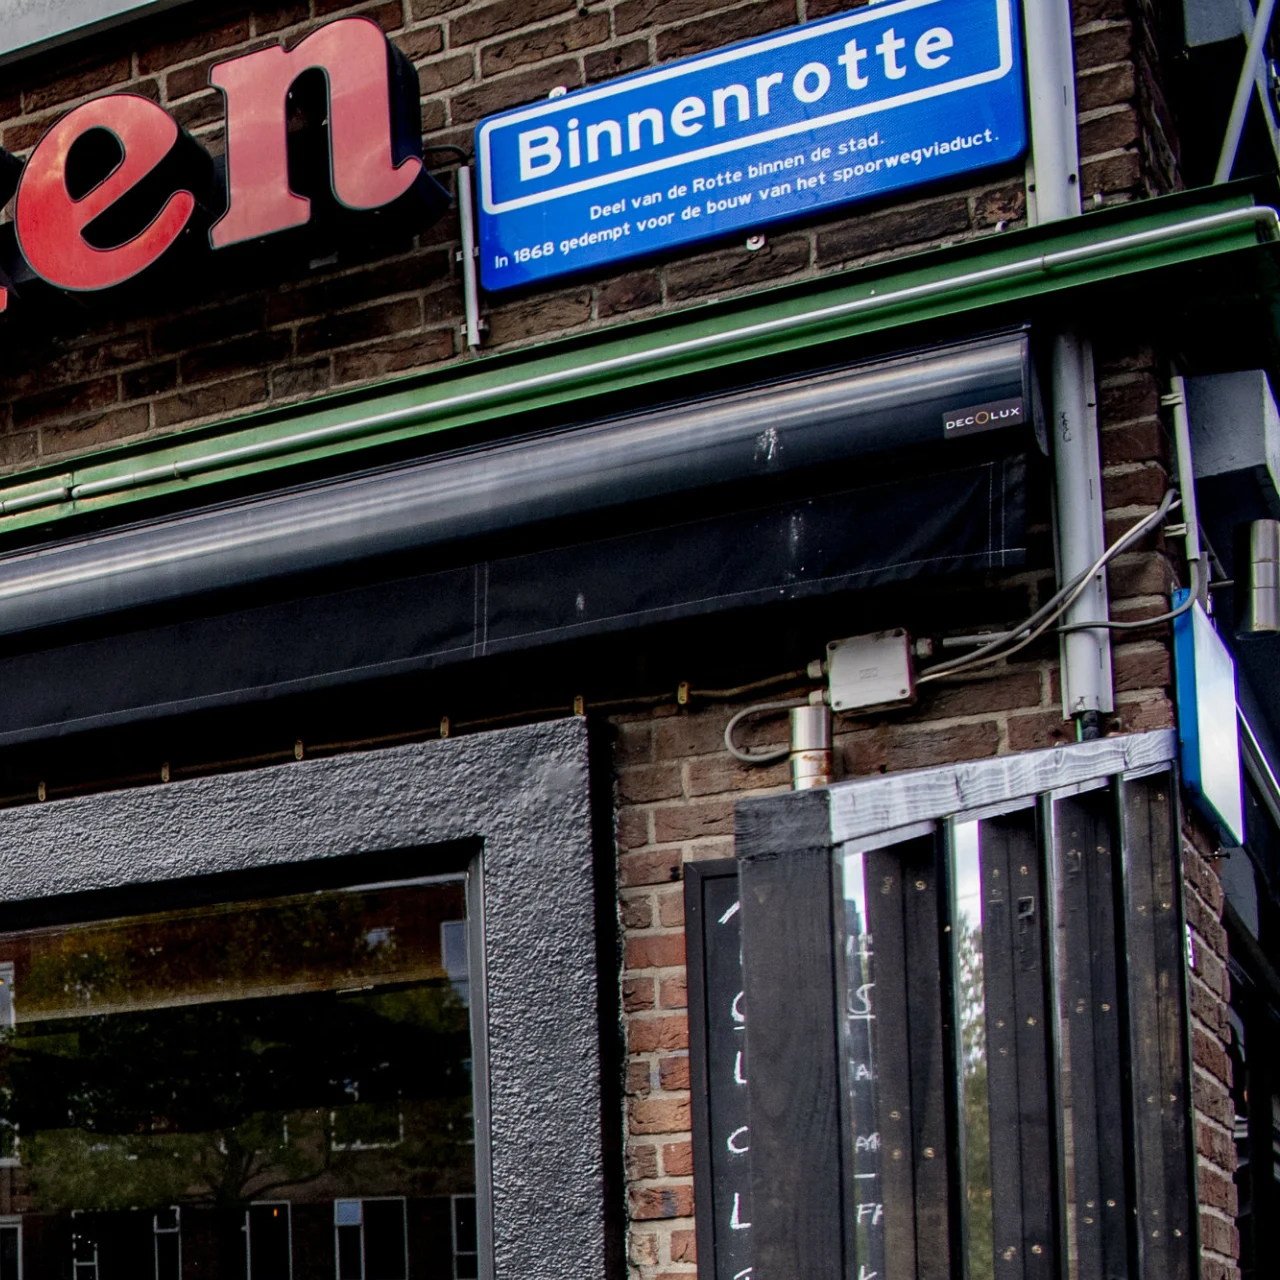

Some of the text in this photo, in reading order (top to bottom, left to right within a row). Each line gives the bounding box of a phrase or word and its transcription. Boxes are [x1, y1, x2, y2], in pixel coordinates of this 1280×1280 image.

[517, 25, 955, 182] Binnenrotte
[495, 127, 1000, 269] In 1868 gedempt voor de bouw van het spoorwegviaduct.
[590, 131, 886, 220] Deel van de Rotte binnen de stad.
[946, 407, 1020, 430] DECOLUX
